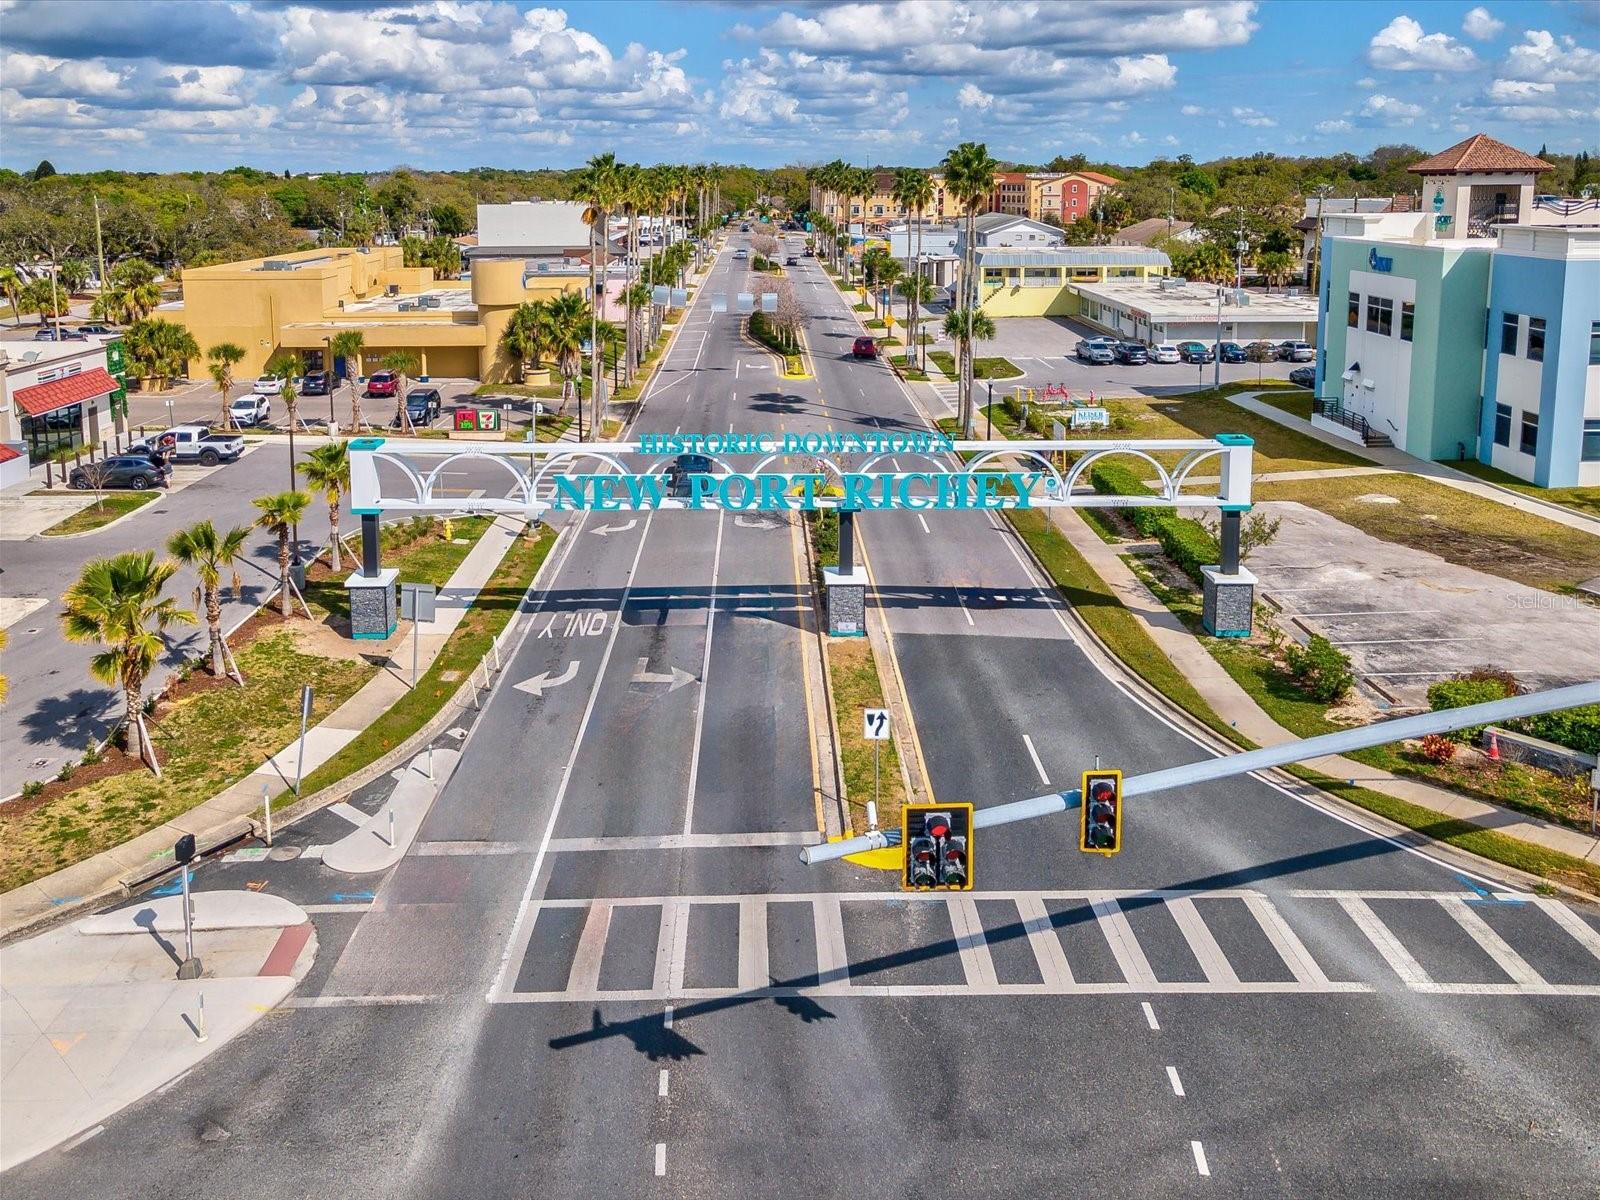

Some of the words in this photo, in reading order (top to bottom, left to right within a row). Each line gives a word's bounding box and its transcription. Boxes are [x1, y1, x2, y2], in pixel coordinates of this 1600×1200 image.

[639, 432, 774, 455] HISTORIC
[782, 431, 956, 454] DOWNTOWN
[552, 473, 672, 511] NEW
[687, 473, 826, 511] PORT
[842, 472, 1044, 510] RICHEY
[537, 612, 608, 639] ONLY
